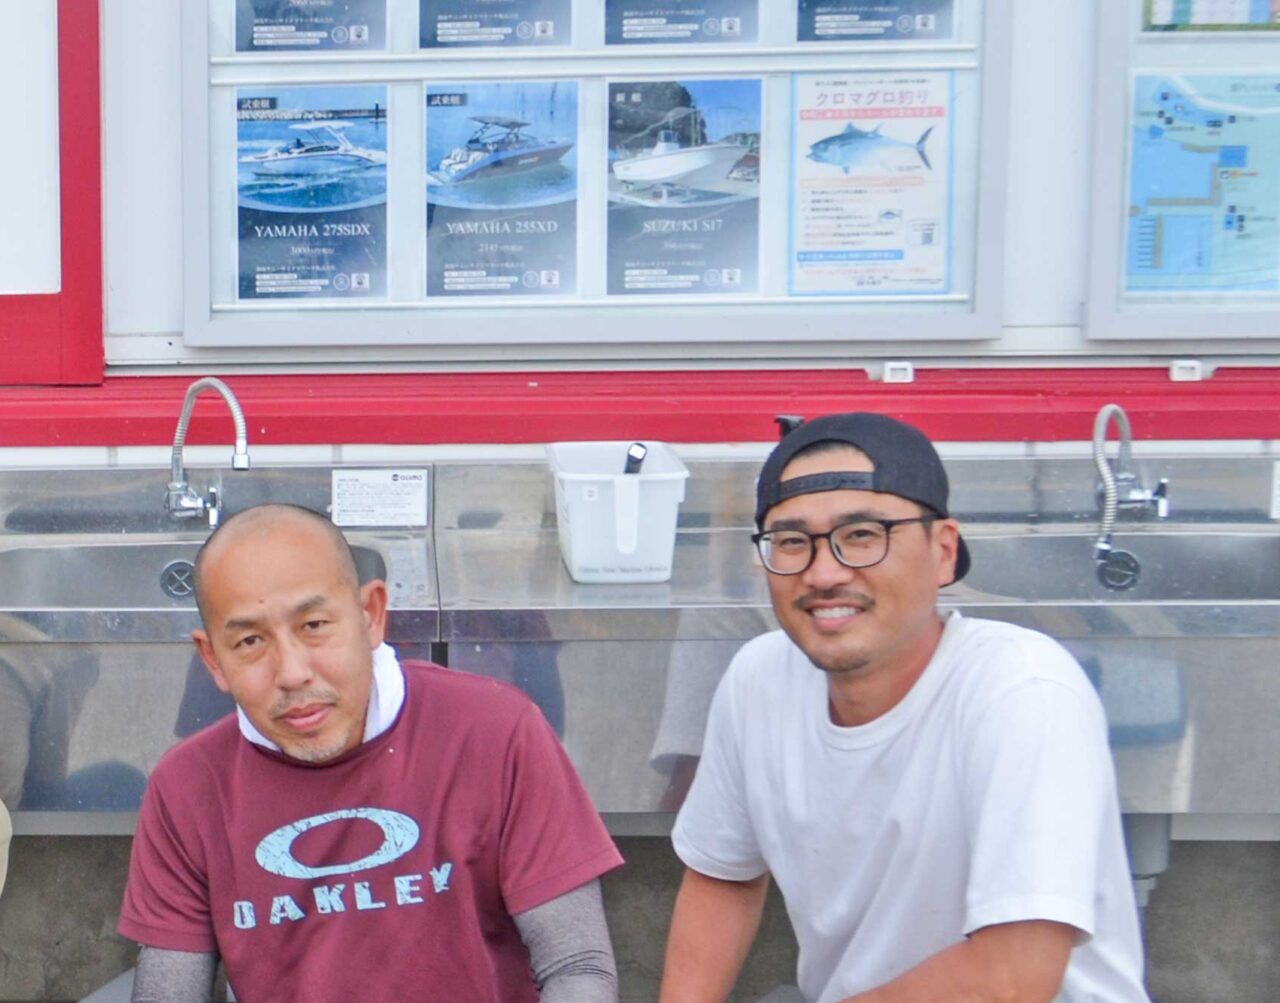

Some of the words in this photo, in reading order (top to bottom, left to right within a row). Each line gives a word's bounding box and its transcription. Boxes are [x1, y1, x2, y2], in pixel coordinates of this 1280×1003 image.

[816, 90, 928, 106] クロマグロ釣り
[254, 224, 319, 238] YAMAHA
[322, 223, 371, 237] 275SDX
[446, 221, 511, 235] YAMAHA
[515, 220, 558, 234] 255XD
[643, 220, 697, 233] SUZUKI
[701, 219, 723, 231] S17
[233, 861, 452, 929] OAKLEY
